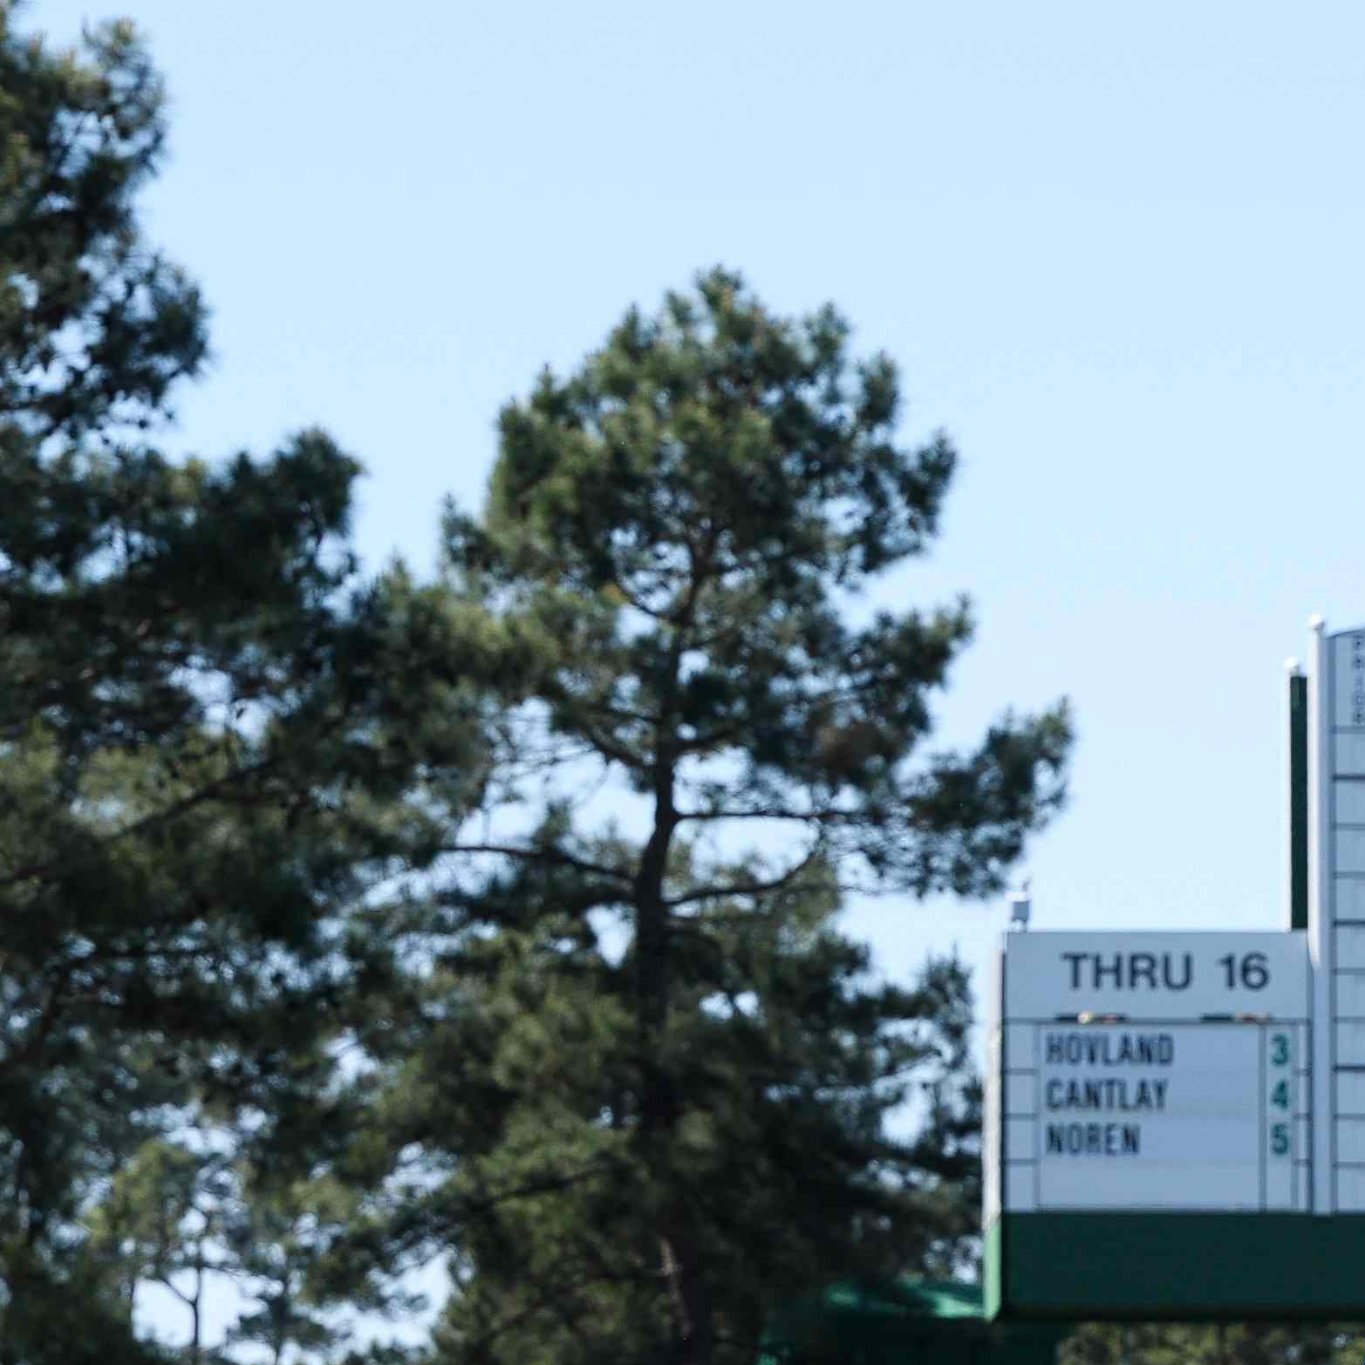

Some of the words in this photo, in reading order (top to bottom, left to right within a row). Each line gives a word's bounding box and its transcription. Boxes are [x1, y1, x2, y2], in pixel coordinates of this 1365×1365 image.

[1060, 952, 1194, 993] THRU
[1218, 951, 1270, 992] 16
[1047, 1034, 1173, 1065] HOVLAND
[1273, 1035, 1290, 1066] 3
[1047, 1079, 1166, 1112] CANTLAY
[1272, 1081, 1289, 1109] 4
[1047, 1124, 1139, 1154] NOREN
[1272, 1124, 1289, 1155] 5
